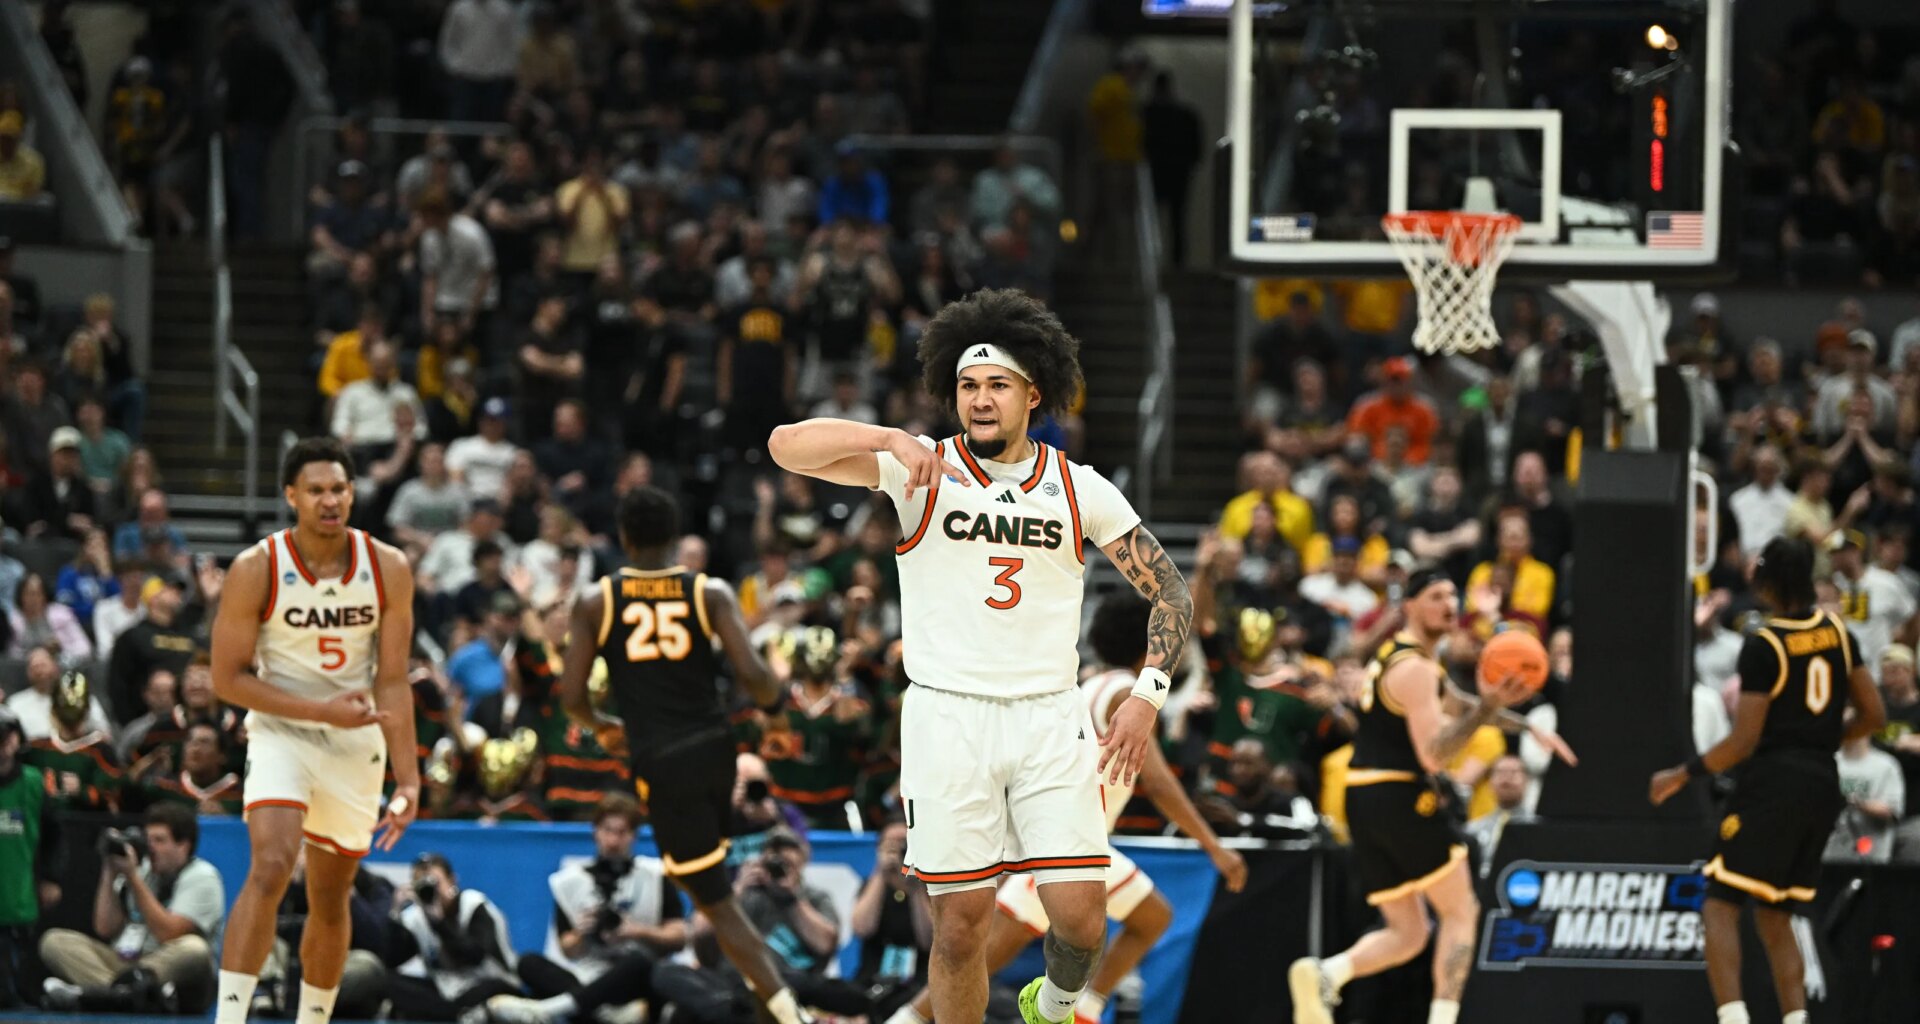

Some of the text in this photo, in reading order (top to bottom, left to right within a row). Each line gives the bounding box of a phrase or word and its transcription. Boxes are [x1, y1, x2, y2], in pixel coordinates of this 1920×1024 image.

[943, 510, 1063, 550] CANES
[984, 556, 1024, 610] 3
[284, 605, 374, 629] CANES
[621, 600, 693, 663] 25
[318, 636, 346, 671] 5
[1805, 654, 1833, 716] 0
[1538, 871, 1667, 911] MARCH
